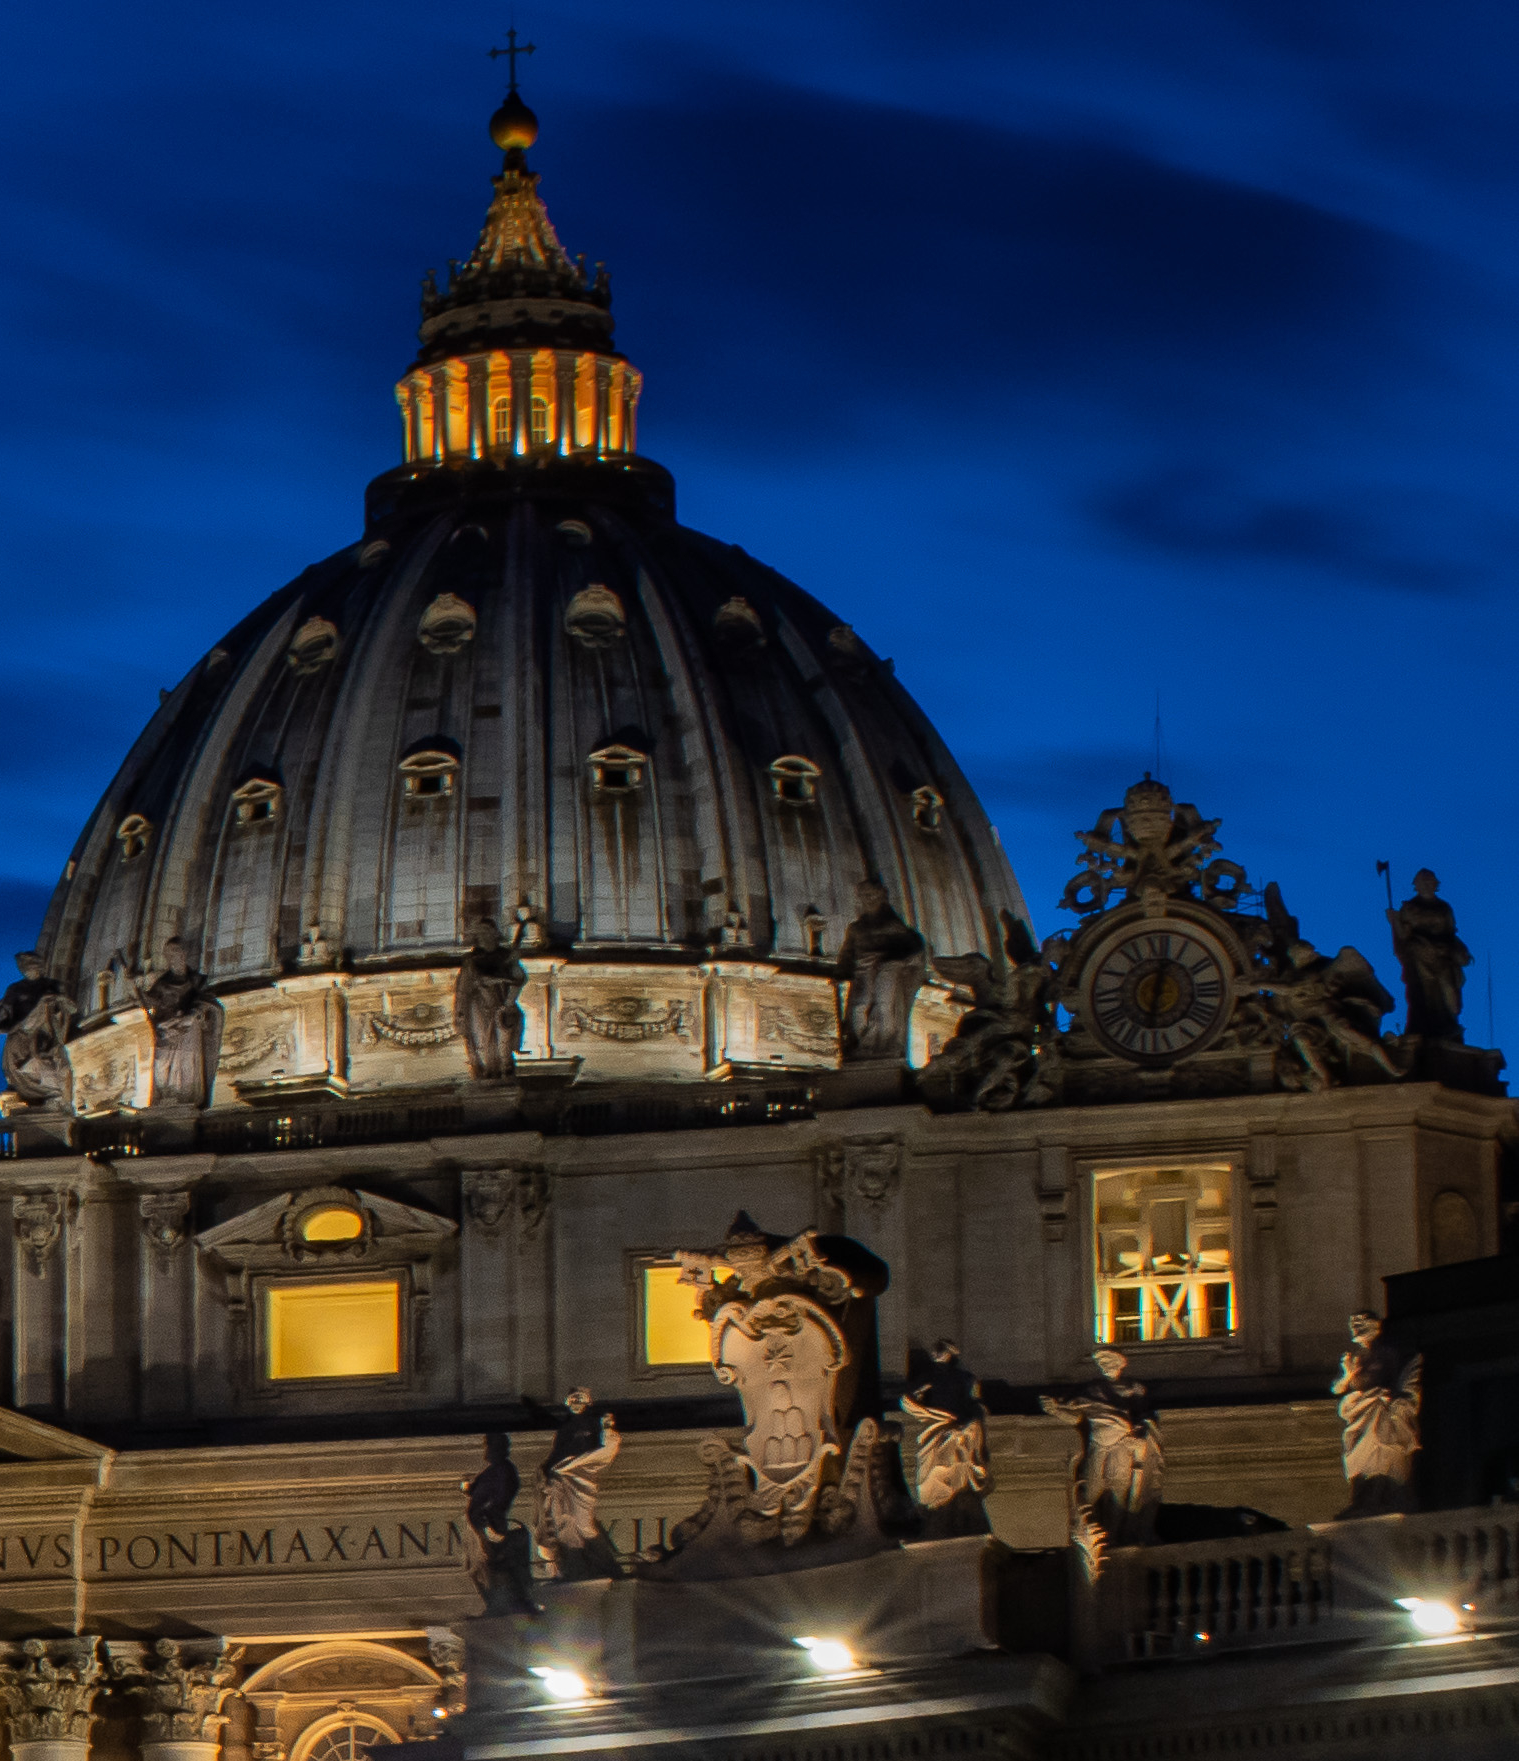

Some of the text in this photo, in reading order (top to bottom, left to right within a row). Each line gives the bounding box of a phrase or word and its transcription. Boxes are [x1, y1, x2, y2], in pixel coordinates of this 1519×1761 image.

[97, 1530, 232, 1572] PONT
[236, 1525, 350, 1565] MAX
[360, 1521, 431, 1560] AN
